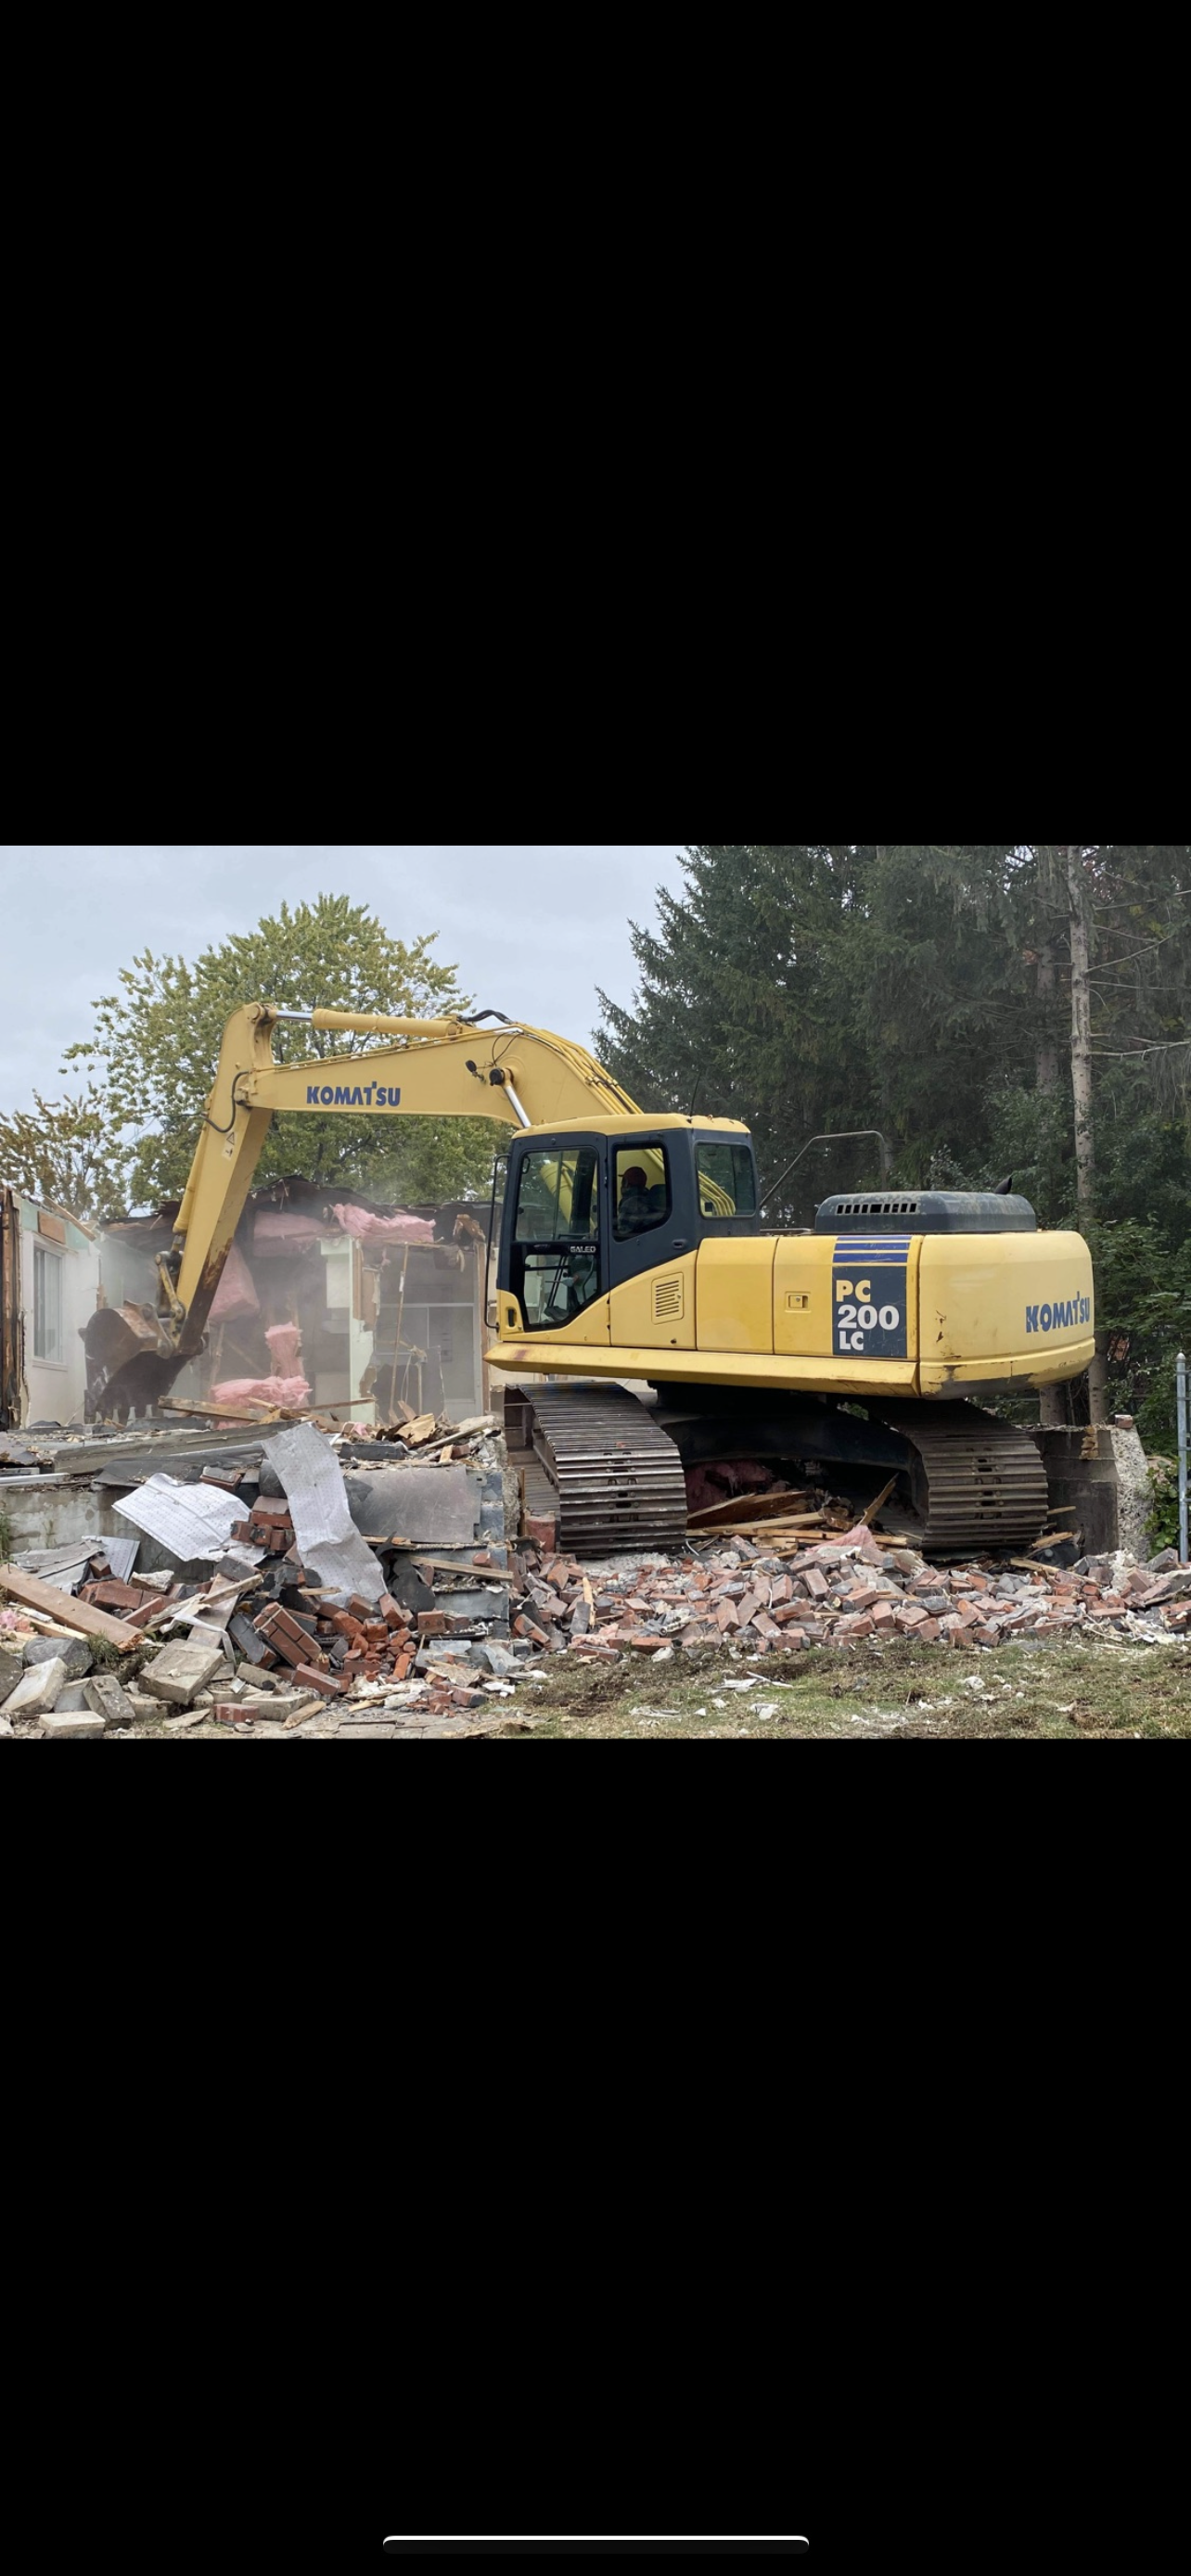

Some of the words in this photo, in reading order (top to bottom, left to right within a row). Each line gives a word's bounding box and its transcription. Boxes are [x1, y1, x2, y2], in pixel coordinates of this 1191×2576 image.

[307, 1081, 401, 1106] KOMATSU
[836, 1280, 871, 1303] PC
[838, 1304, 900, 1331] 200
[1026, 1291, 1090, 1333] KOMATSU
[839, 1331, 864, 1351] LC
